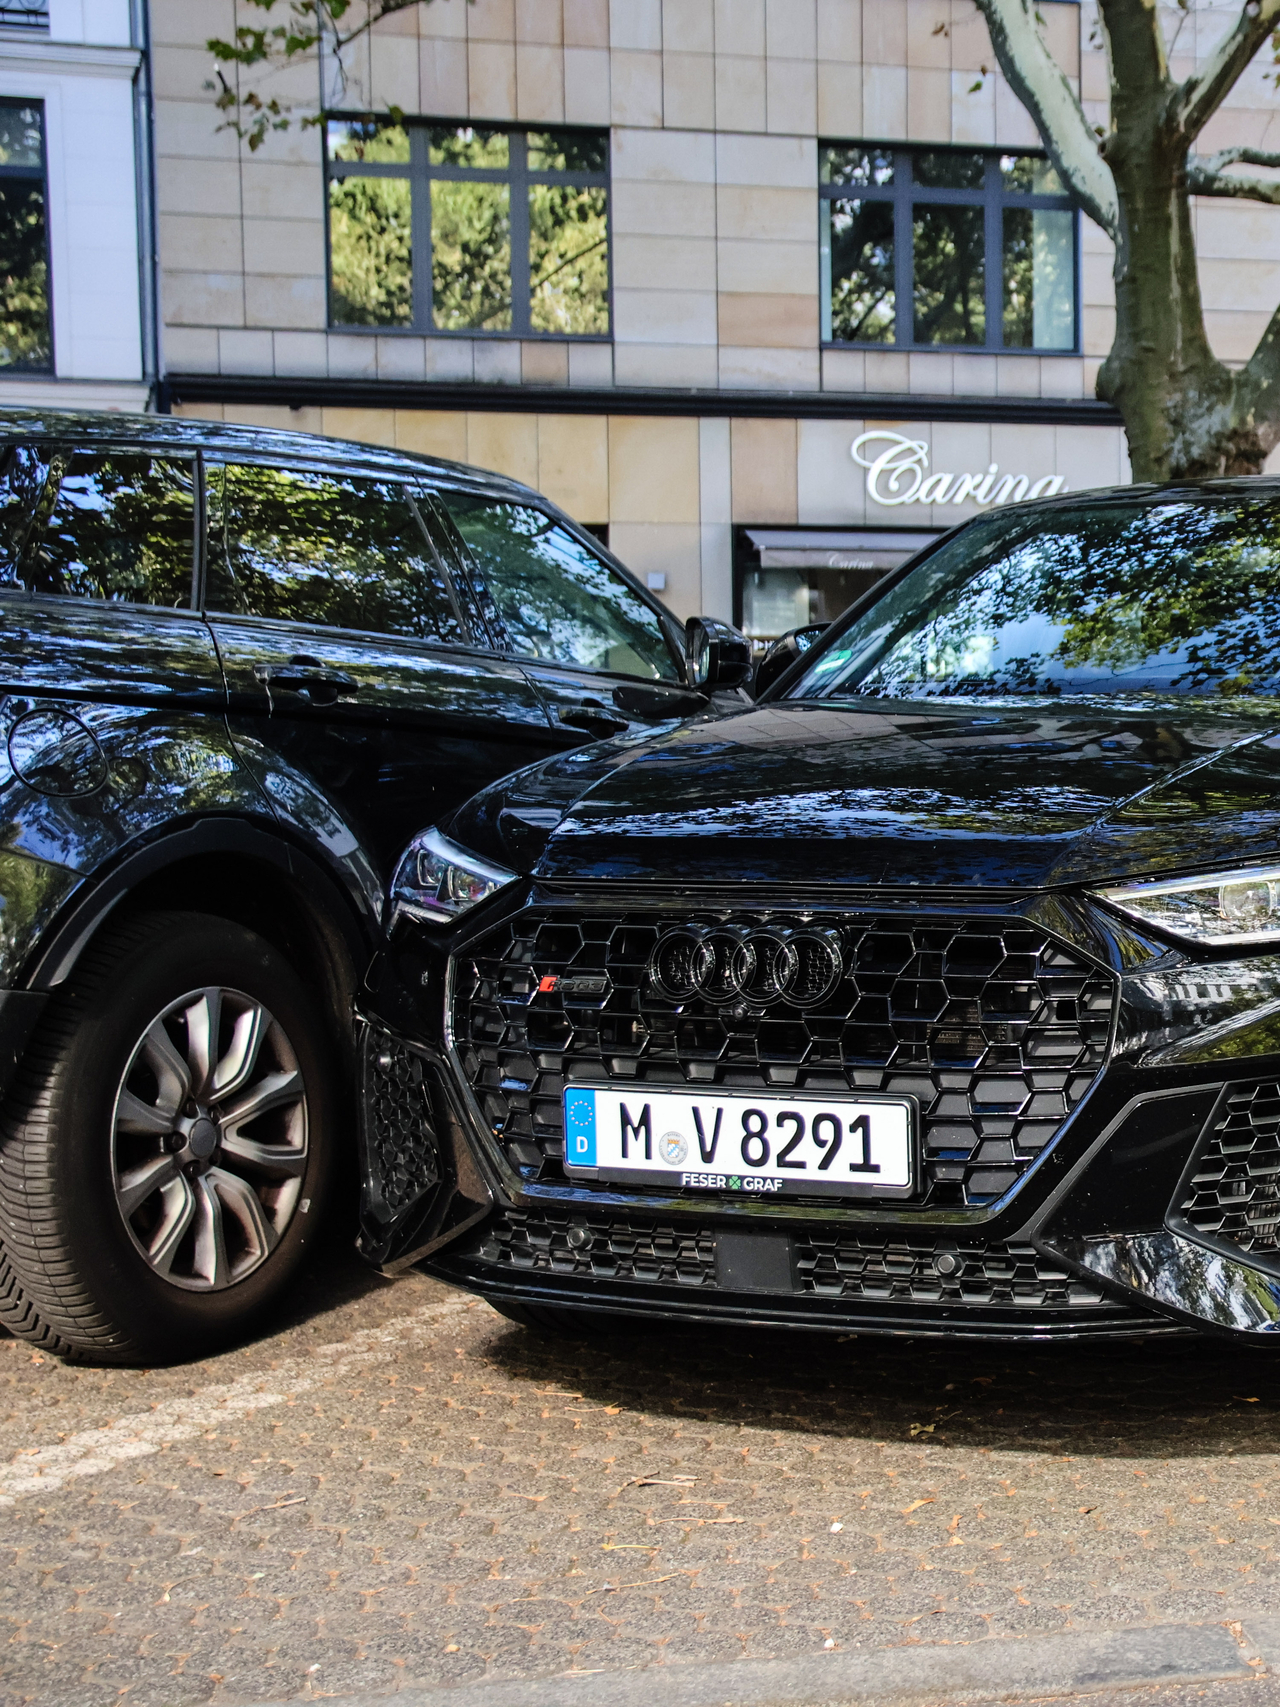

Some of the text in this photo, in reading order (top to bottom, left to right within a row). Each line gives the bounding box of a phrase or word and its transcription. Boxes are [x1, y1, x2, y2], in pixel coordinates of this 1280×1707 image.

[851, 430, 1069, 506] Carina
[576, 1136, 588, 1152] D
[619, 1102, 881, 1173] M V 8291
[682, 1172, 783, 1191] FESER GRAF
